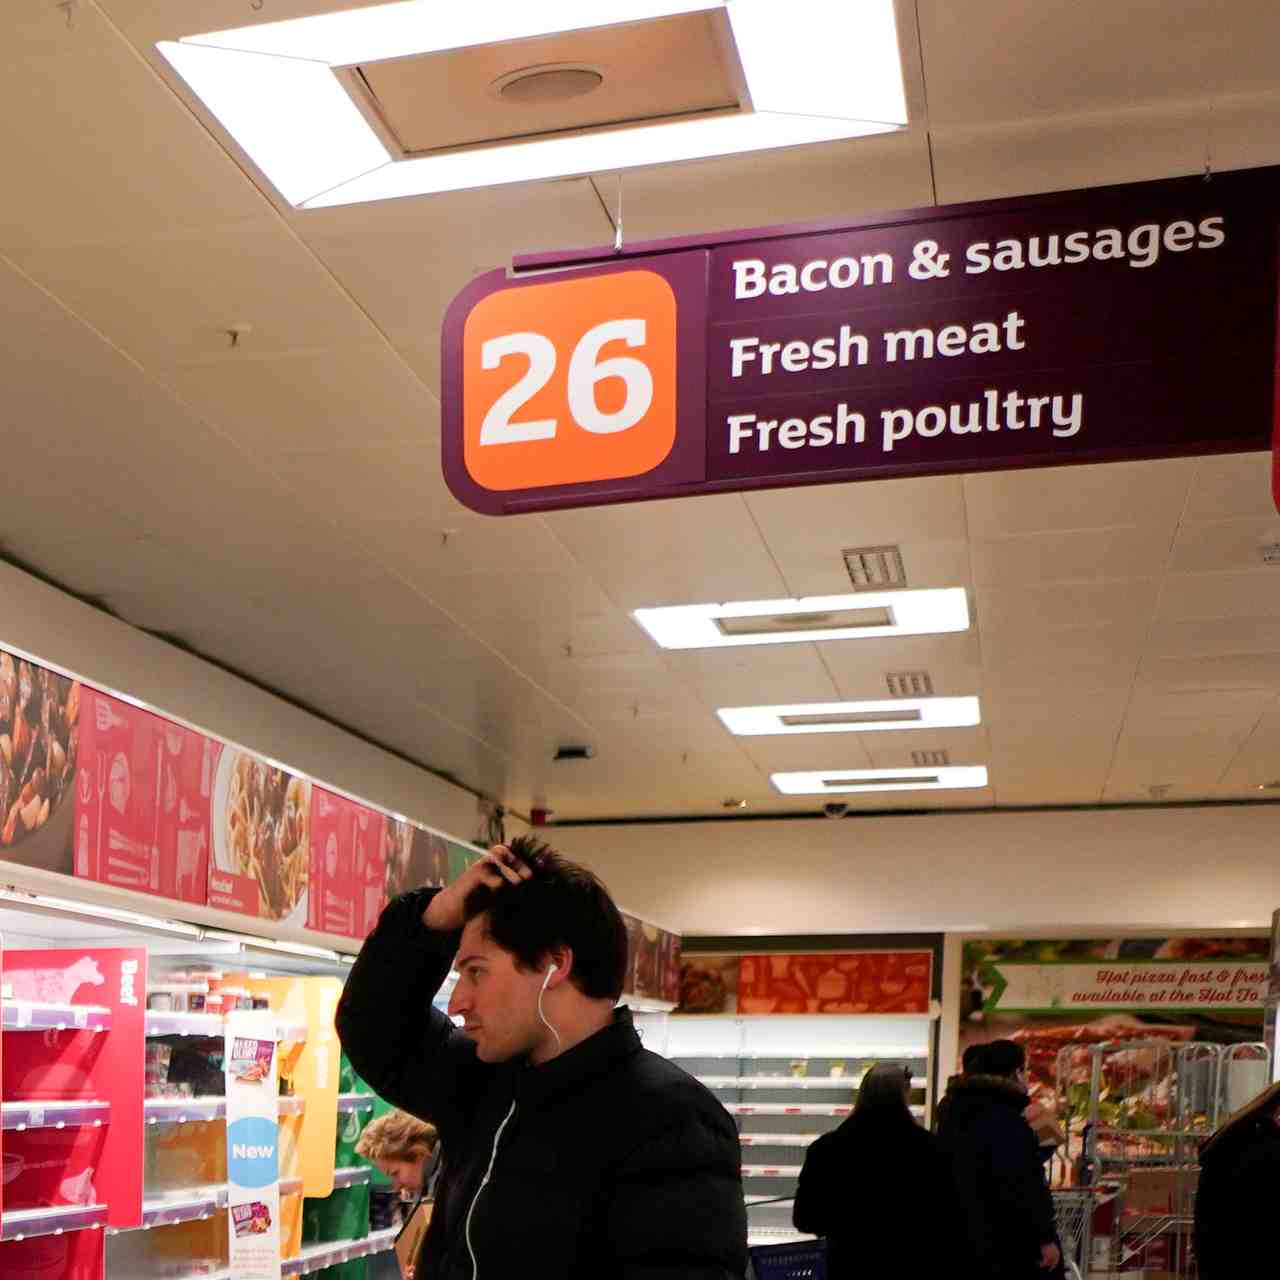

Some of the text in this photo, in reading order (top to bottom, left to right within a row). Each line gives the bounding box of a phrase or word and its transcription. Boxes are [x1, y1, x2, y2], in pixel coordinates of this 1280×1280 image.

[733, 214, 1227, 299] Bacon & sausages
[729, 310, 1026, 377] Fresh meat
[478, 315, 655, 446] 26
[726, 389, 1085, 455] Fresh poultry
[120, 959, 139, 1008] Beef
[1071, 987, 1145, 1003] available
[1150, 989, 1167, 1003] at
[1168, 988, 1194, 1002] the
[1096, 969, 1129, 985] Hot
[1130, 972, 1177, 988] pizza
[1177, 969, 1213, 987] fast
[232, 1142, 274, 1160] New
